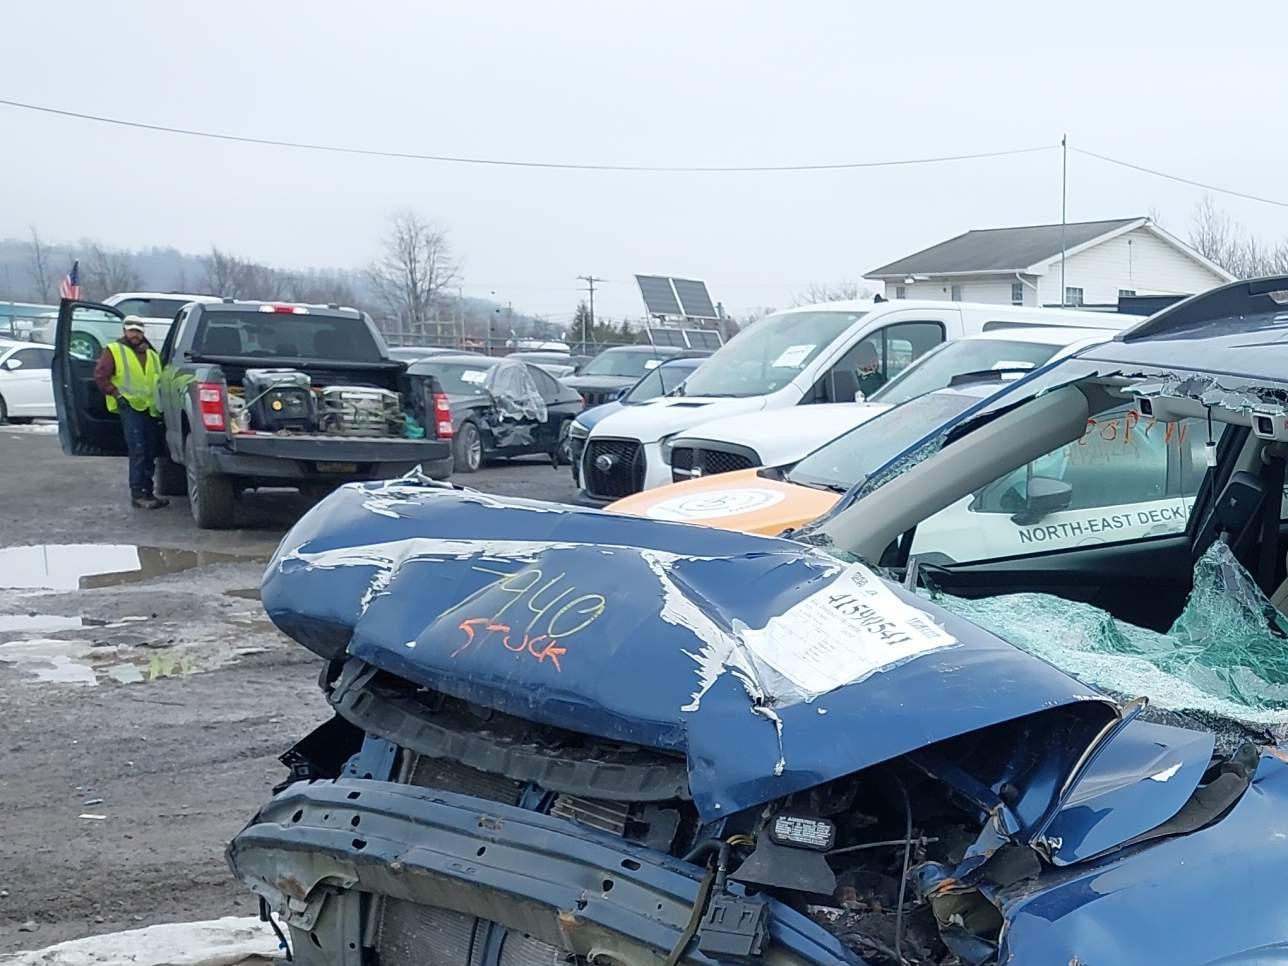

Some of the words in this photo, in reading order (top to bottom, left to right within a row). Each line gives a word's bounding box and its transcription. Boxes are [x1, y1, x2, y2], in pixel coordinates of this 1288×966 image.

[1019, 513, 1136, 544] NORTH-EAST
[1138, 506, 1185, 525] DECK
[450, 617, 568, 672] STUCK
[828, 593, 913, 645] 41590541
